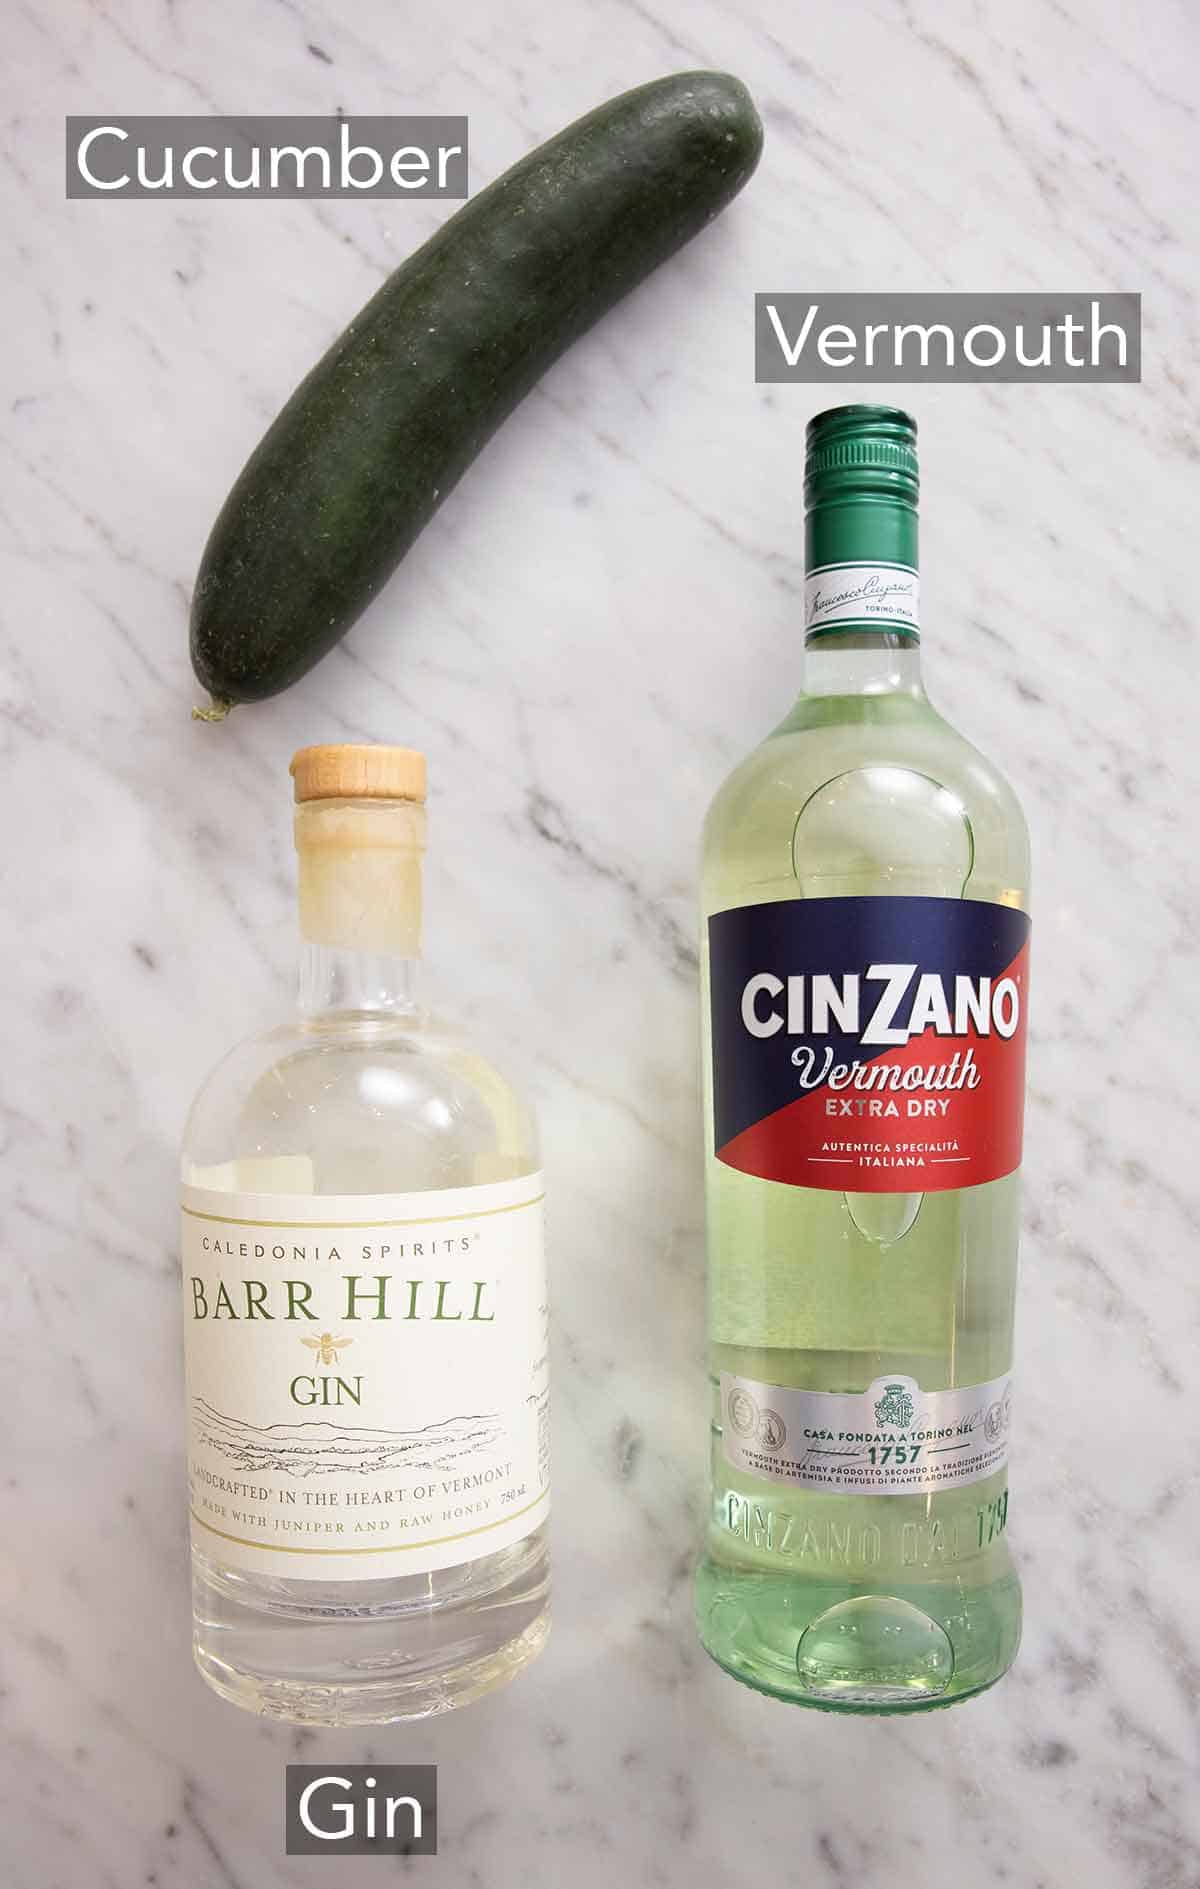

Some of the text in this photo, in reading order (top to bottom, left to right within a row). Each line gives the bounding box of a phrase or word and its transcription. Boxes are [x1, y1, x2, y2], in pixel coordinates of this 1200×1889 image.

[741, 963, 1019, 1045] CINZANO
[790, 1046, 980, 1091] Vermouth
[825, 1099, 950, 1117] EXTRA DRY
[822, 1138, 959, 1153] AUTENTICA SPECIALITÀ
[859, 1155, 925, 1167] ITALIANA
[202, 1237, 341, 1260] CALEDONIA
[190, 1275, 495, 1321] BARR HILL
[290, 1375, 364, 1407] GIN
[803, 1424, 973, 1442] CASA FONDATA A TORINO NEL
[867, 1445, 922, 1465] 1757
[809, 1464, 828, 1474] DRY
[830, 1467, 882, 1476] PRODOTTO
[884, 1466, 928, 1476] SECONDO
[844, 1476, 875, 1485] INFUSI
[877, 1476, 887, 1485] DI
[890, 1475, 922, 1485] PIANTE
[279, 1490, 297, 1505] IN
[302, 1492, 338, 1506] THE
[345, 1489, 406, 1506] HEART
[413, 1484, 436, 1500] OF
[441, 1462, 512, 1495] VERMONT
[232, 1510, 266, 1527] WITH
[273, 1519, 345, 1533] JUNIPER
[354, 1520, 390, 1533] AND
[399, 1513, 433, 1529] RAW
[442, 1499, 490, 1521] HONEY
